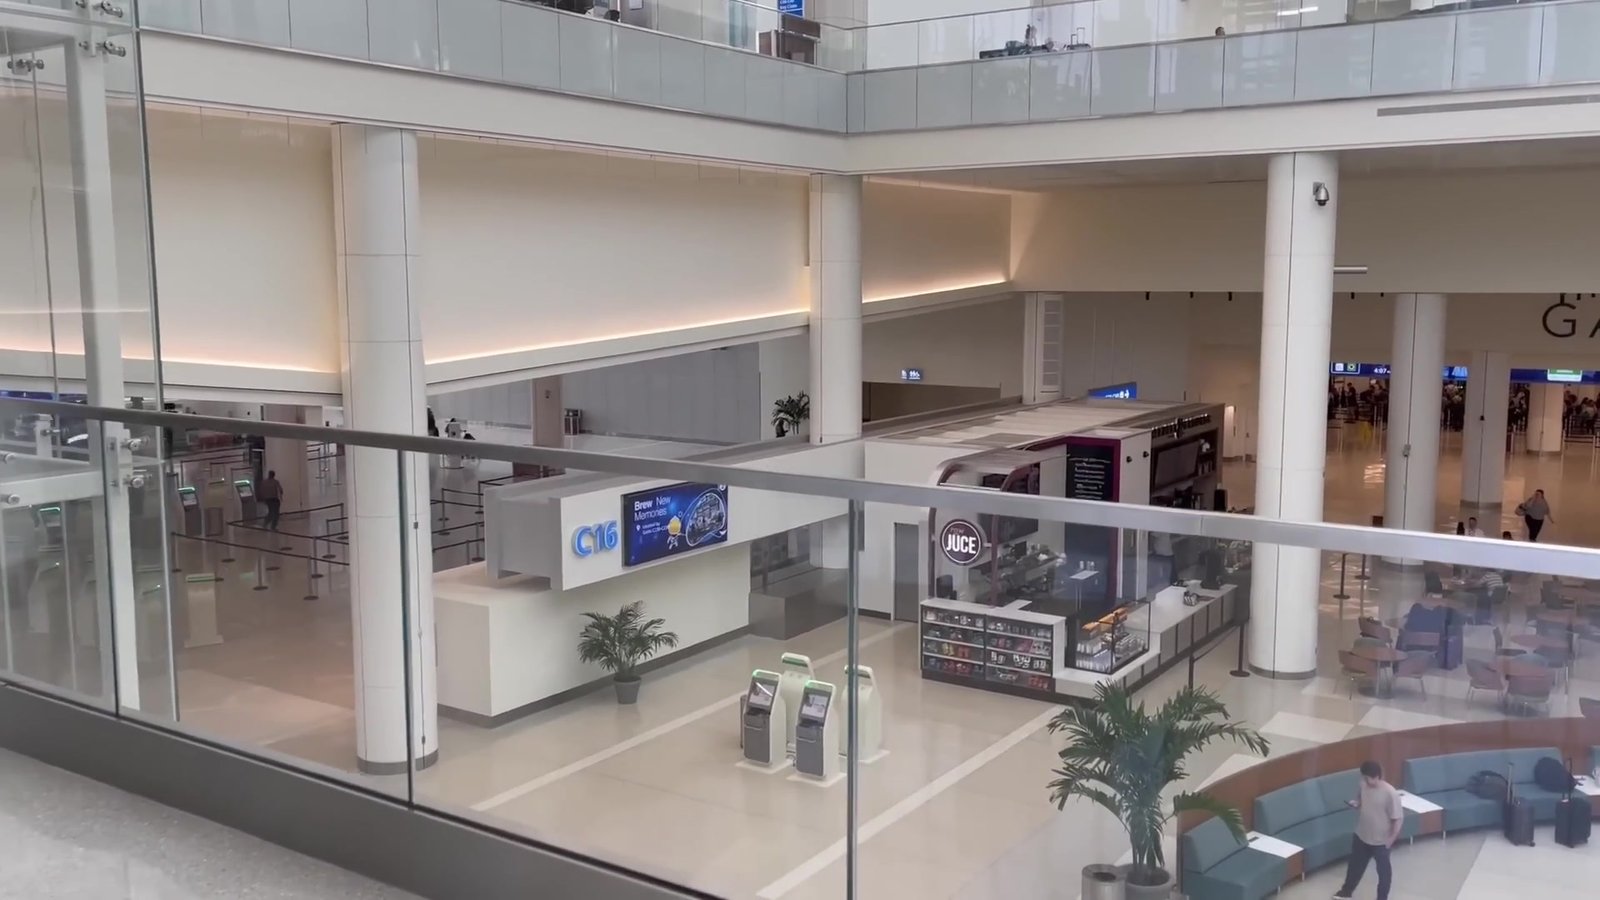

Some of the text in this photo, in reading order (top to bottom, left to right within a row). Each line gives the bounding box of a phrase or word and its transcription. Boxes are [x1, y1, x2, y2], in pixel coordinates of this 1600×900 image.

[635, 496, 671, 511] Brew New
[635, 508, 667, 521] Memories
[572, 520, 618, 557] C16
[946, 533, 976, 554] JUCE
